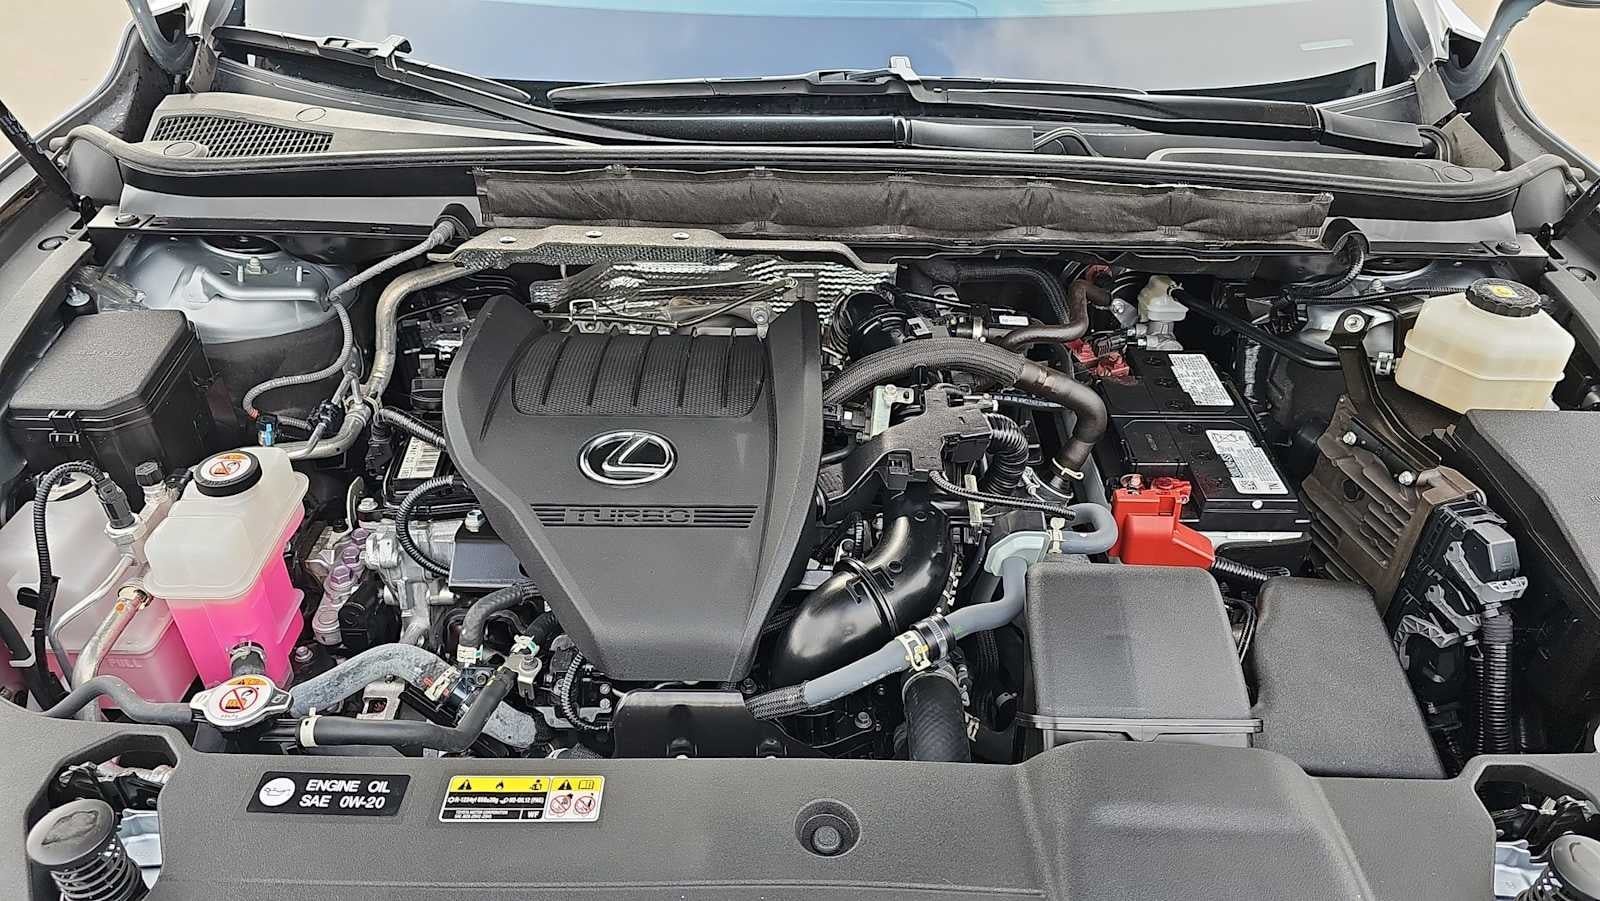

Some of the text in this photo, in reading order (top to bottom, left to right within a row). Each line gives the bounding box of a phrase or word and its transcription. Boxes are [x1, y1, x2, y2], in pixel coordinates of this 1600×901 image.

[565, 506, 693, 523] TURBO
[107, 658, 144, 669] FULL
[305, 779, 391, 793] ENGINE OIL
[299, 794, 386, 809] SAE 0W-20
[527, 810, 540, 819] WF
